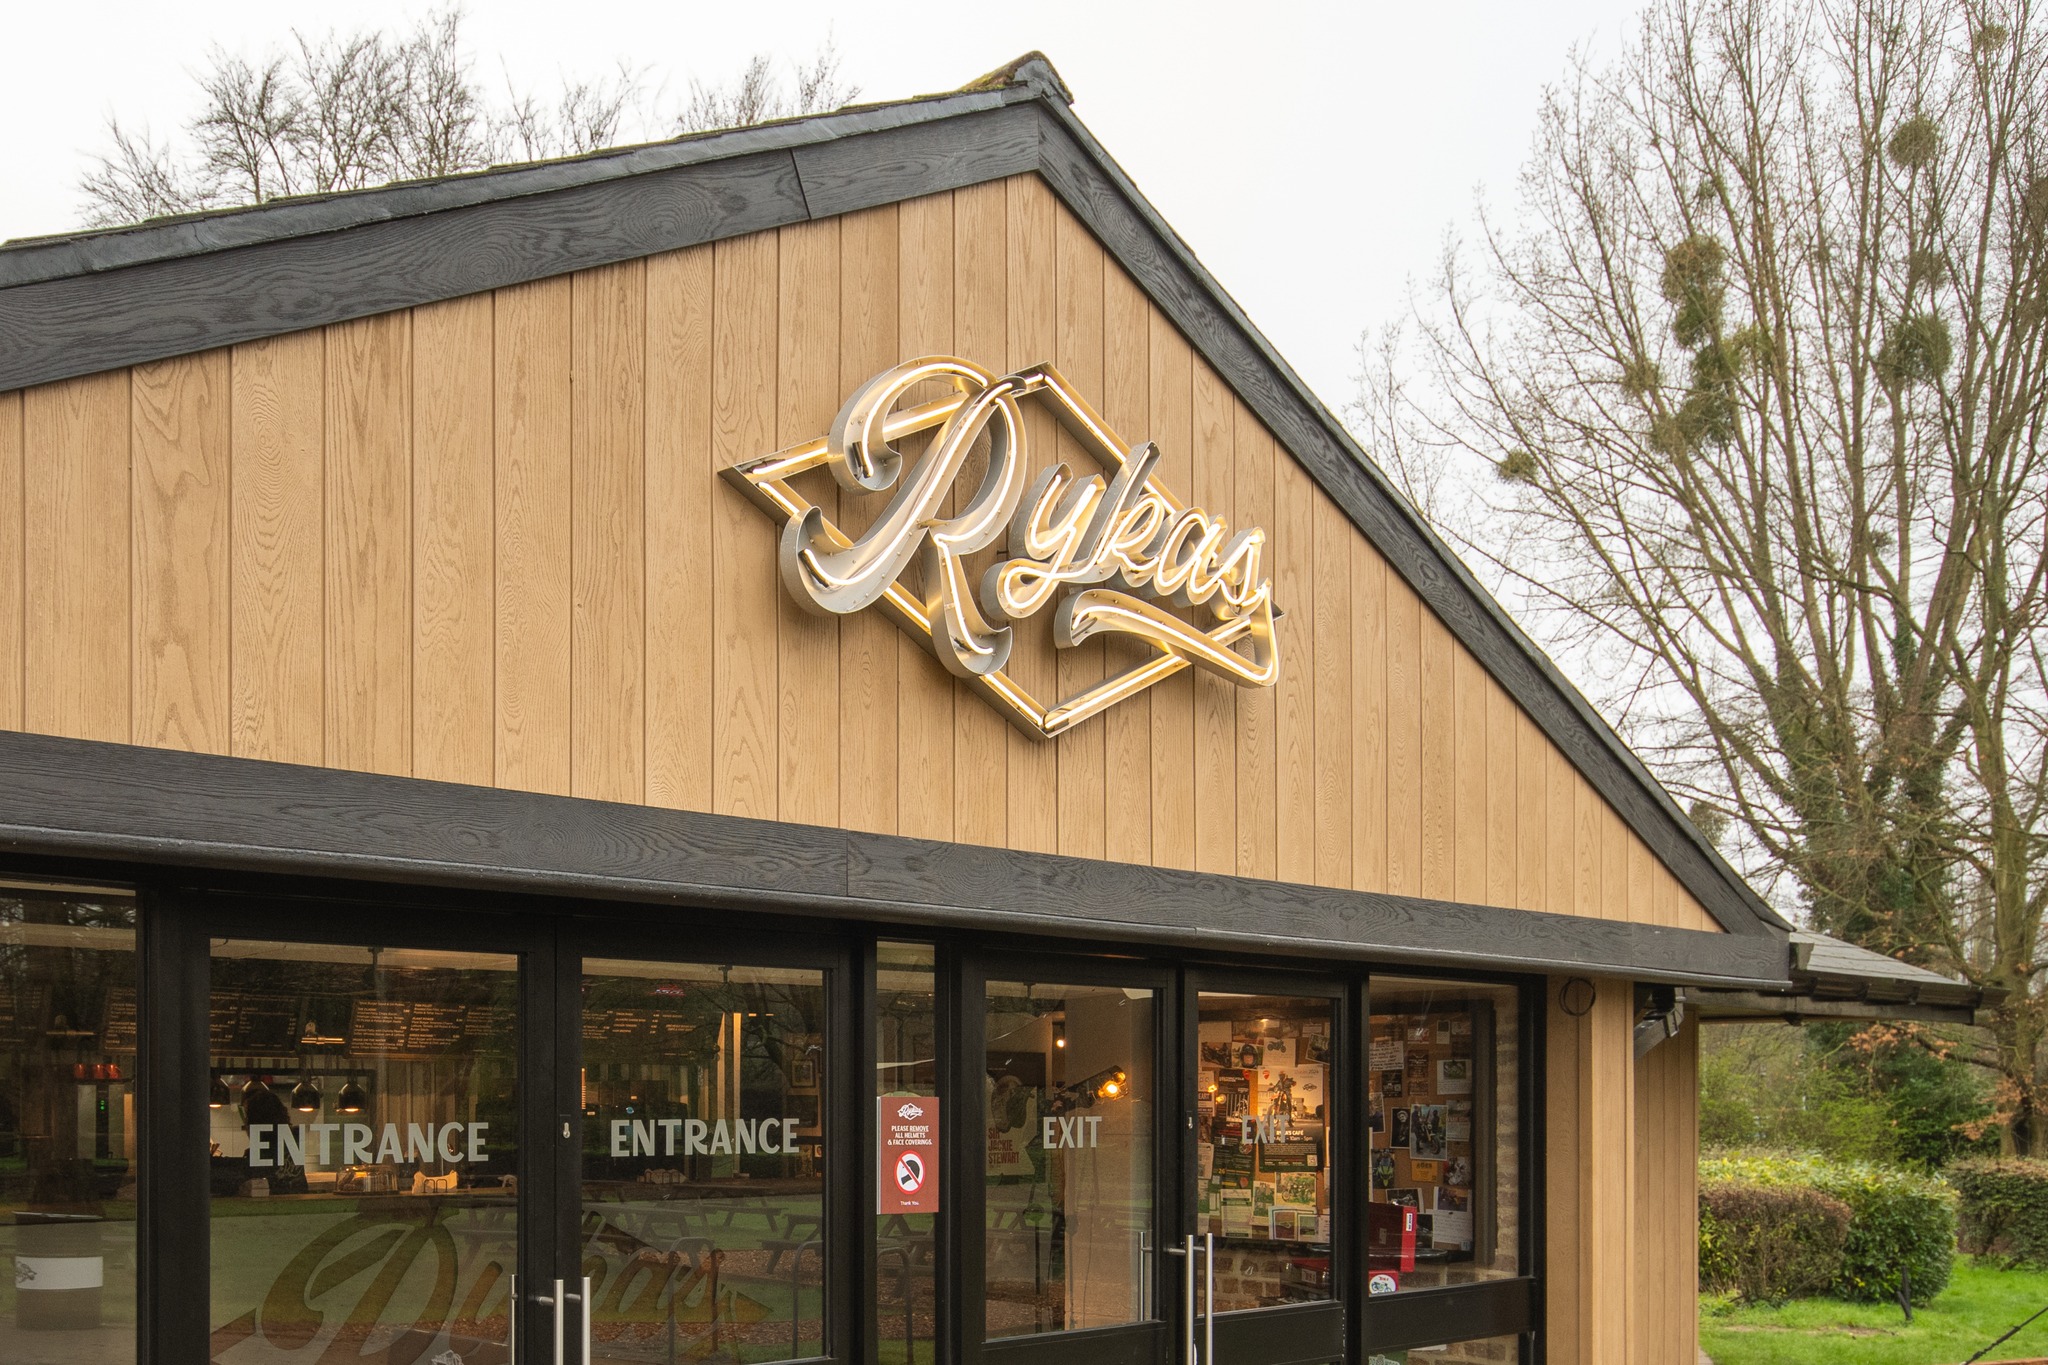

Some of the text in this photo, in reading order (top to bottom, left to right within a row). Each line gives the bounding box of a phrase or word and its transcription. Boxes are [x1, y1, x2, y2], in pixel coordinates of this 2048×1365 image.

[780, 355, 1279, 687] Rykas
[249, 1121, 488, 1167] ENTRANCE
[611, 1117, 800, 1157] ENTRANCE
[988, 1140, 1012, 1151] JACKIE
[1043, 1116, 1102, 1149] EXIT
[1242, 1115, 1289, 1144] EXIT
[988, 1152, 1019, 1163] STEWART
